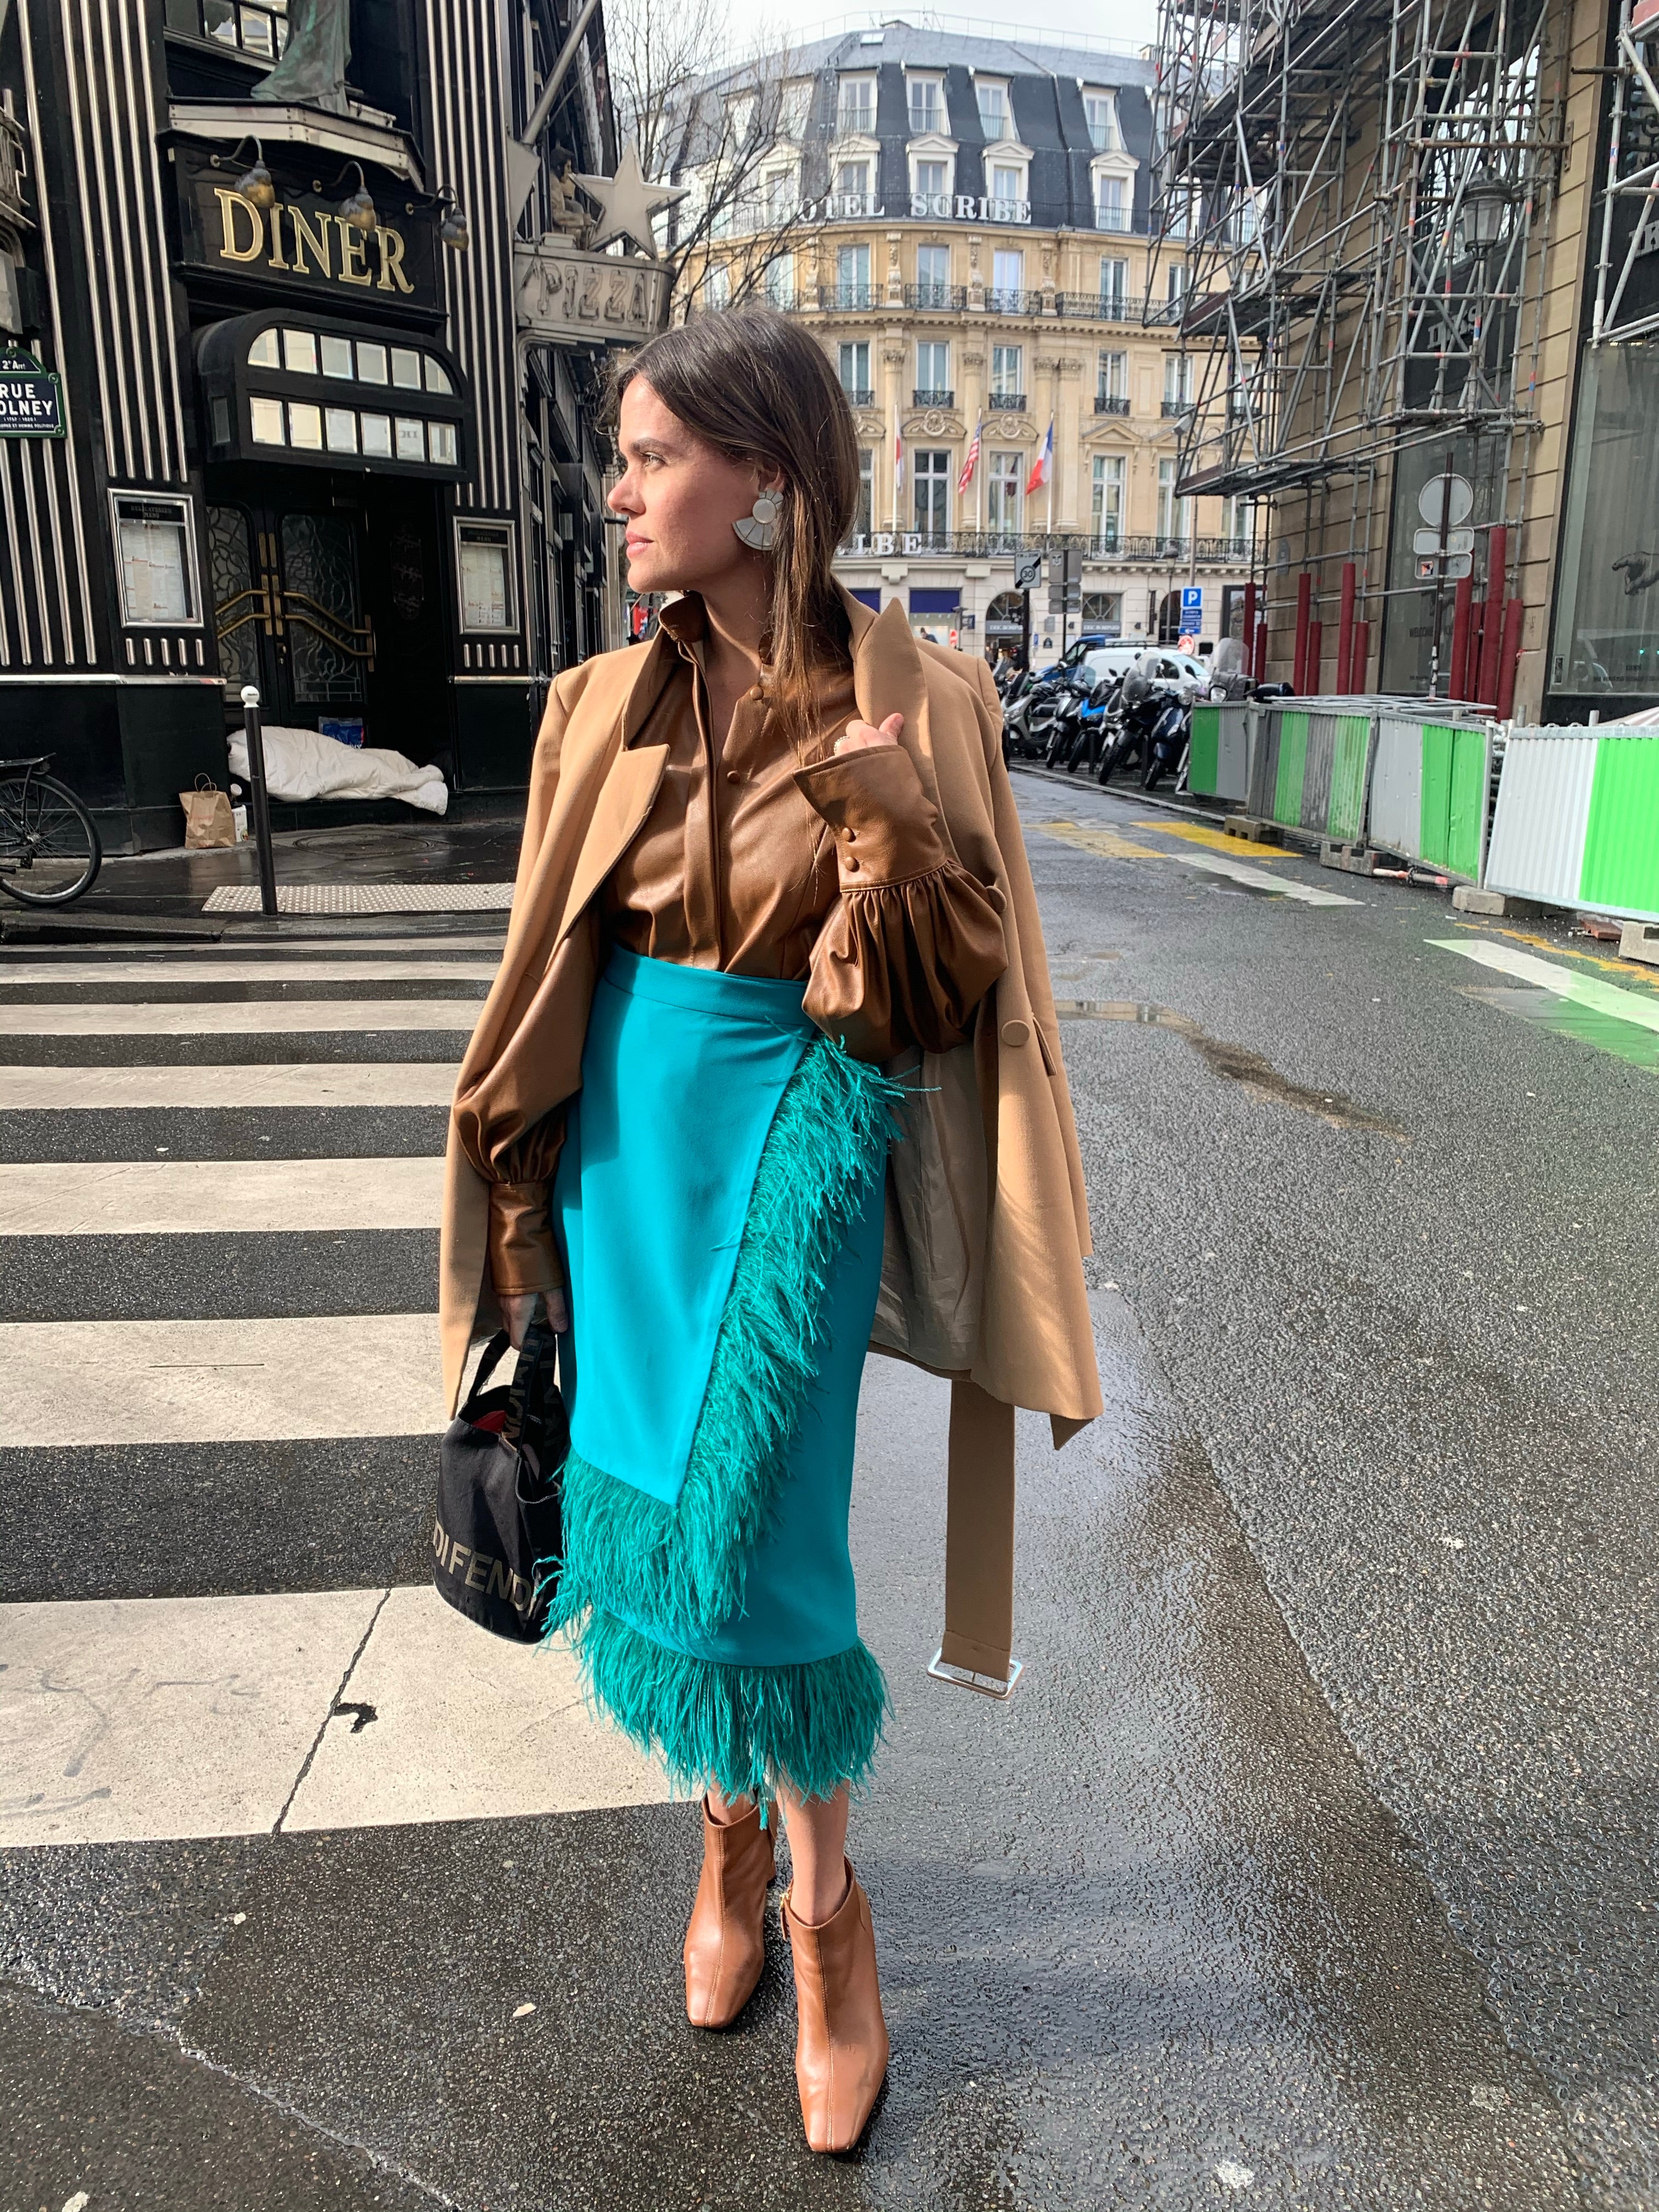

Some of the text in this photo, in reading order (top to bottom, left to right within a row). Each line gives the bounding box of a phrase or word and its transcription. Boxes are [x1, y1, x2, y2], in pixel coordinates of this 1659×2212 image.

[911, 193, 1031, 224] SCRIBE
[214, 188, 415, 294] DINER
[537, 262, 648, 323] PIZZA
[0, 383, 36, 399] RUE
[0, 400, 53, 416] OLNEY
[838, 533, 922, 555] IBE
[1187, 590, 1199, 605] P
